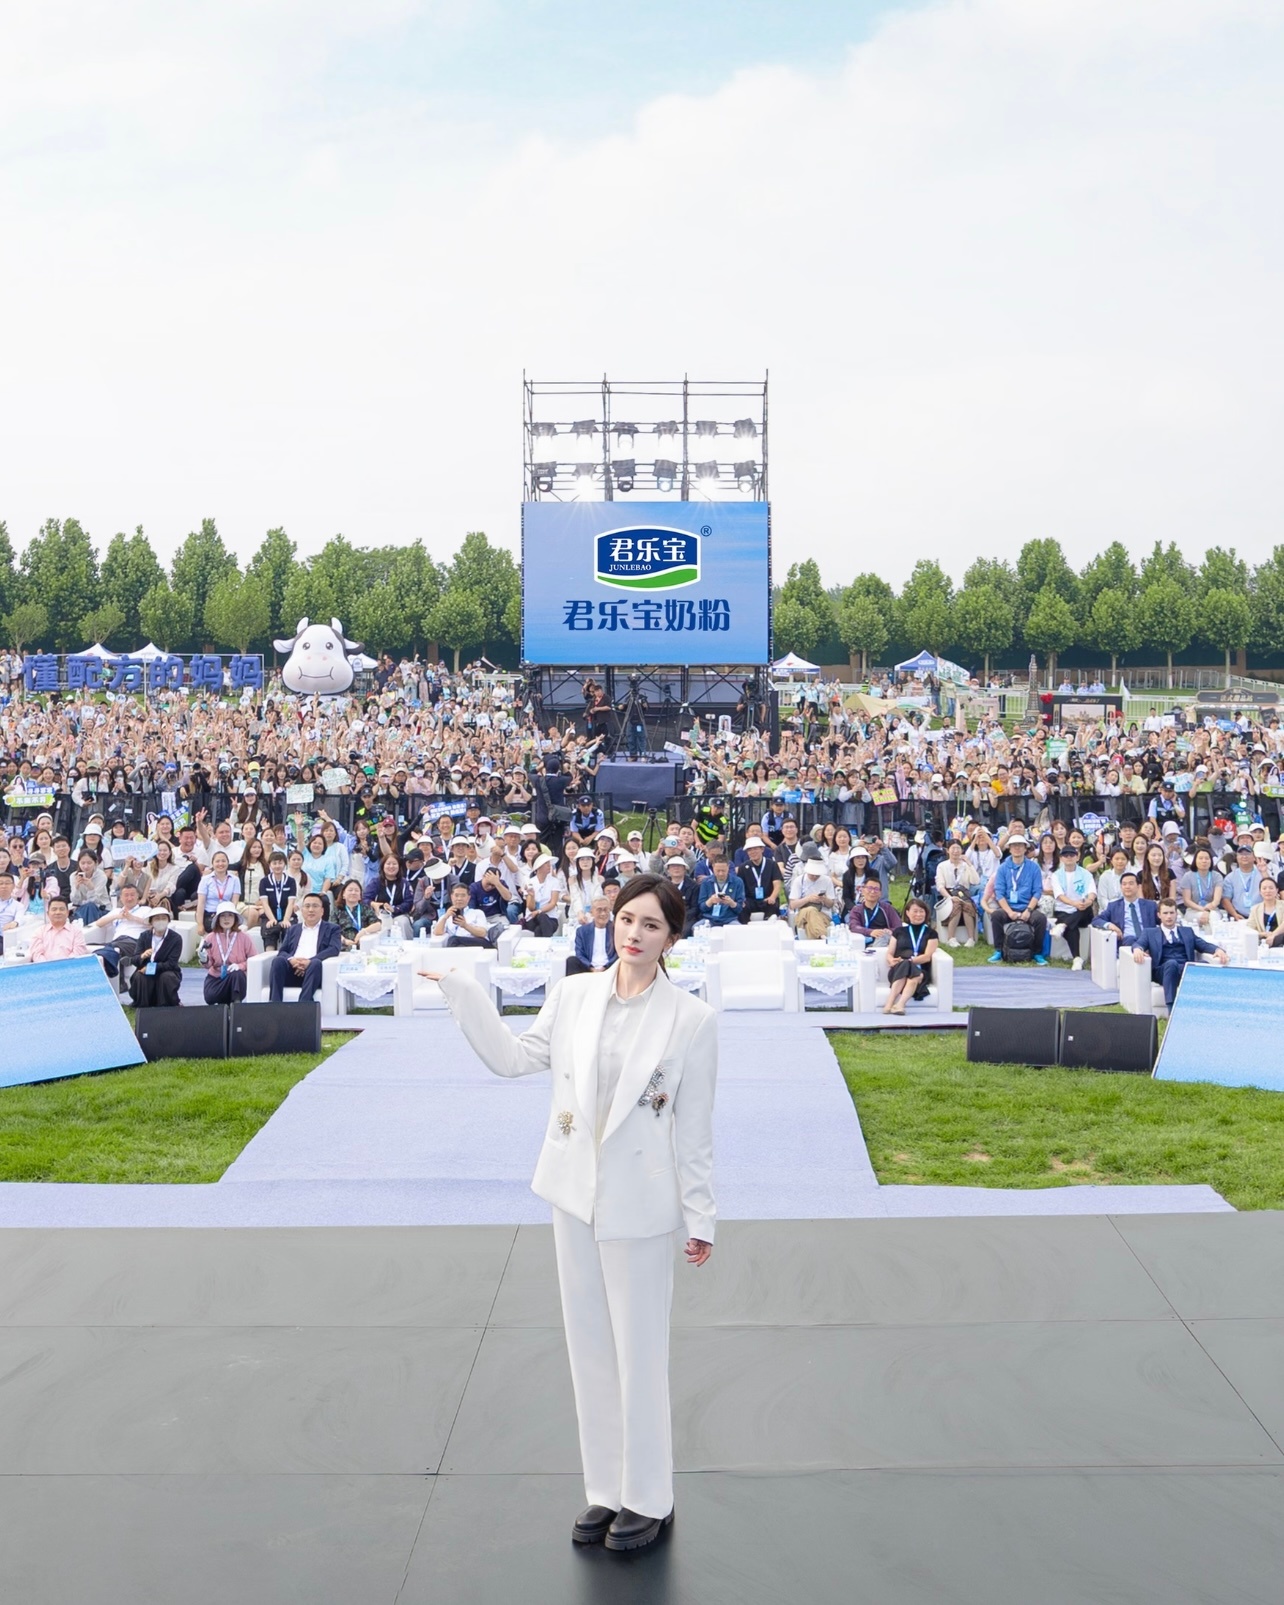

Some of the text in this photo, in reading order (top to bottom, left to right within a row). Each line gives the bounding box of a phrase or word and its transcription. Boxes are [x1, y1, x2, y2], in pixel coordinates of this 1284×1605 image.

[609, 537, 687, 563] 君乐宝
[609, 564, 652, 572] JUNLEBAO
[562, 598, 731, 632] 君乐宝奶粉
[22, 653, 263, 692] 懂配方的妈妈
